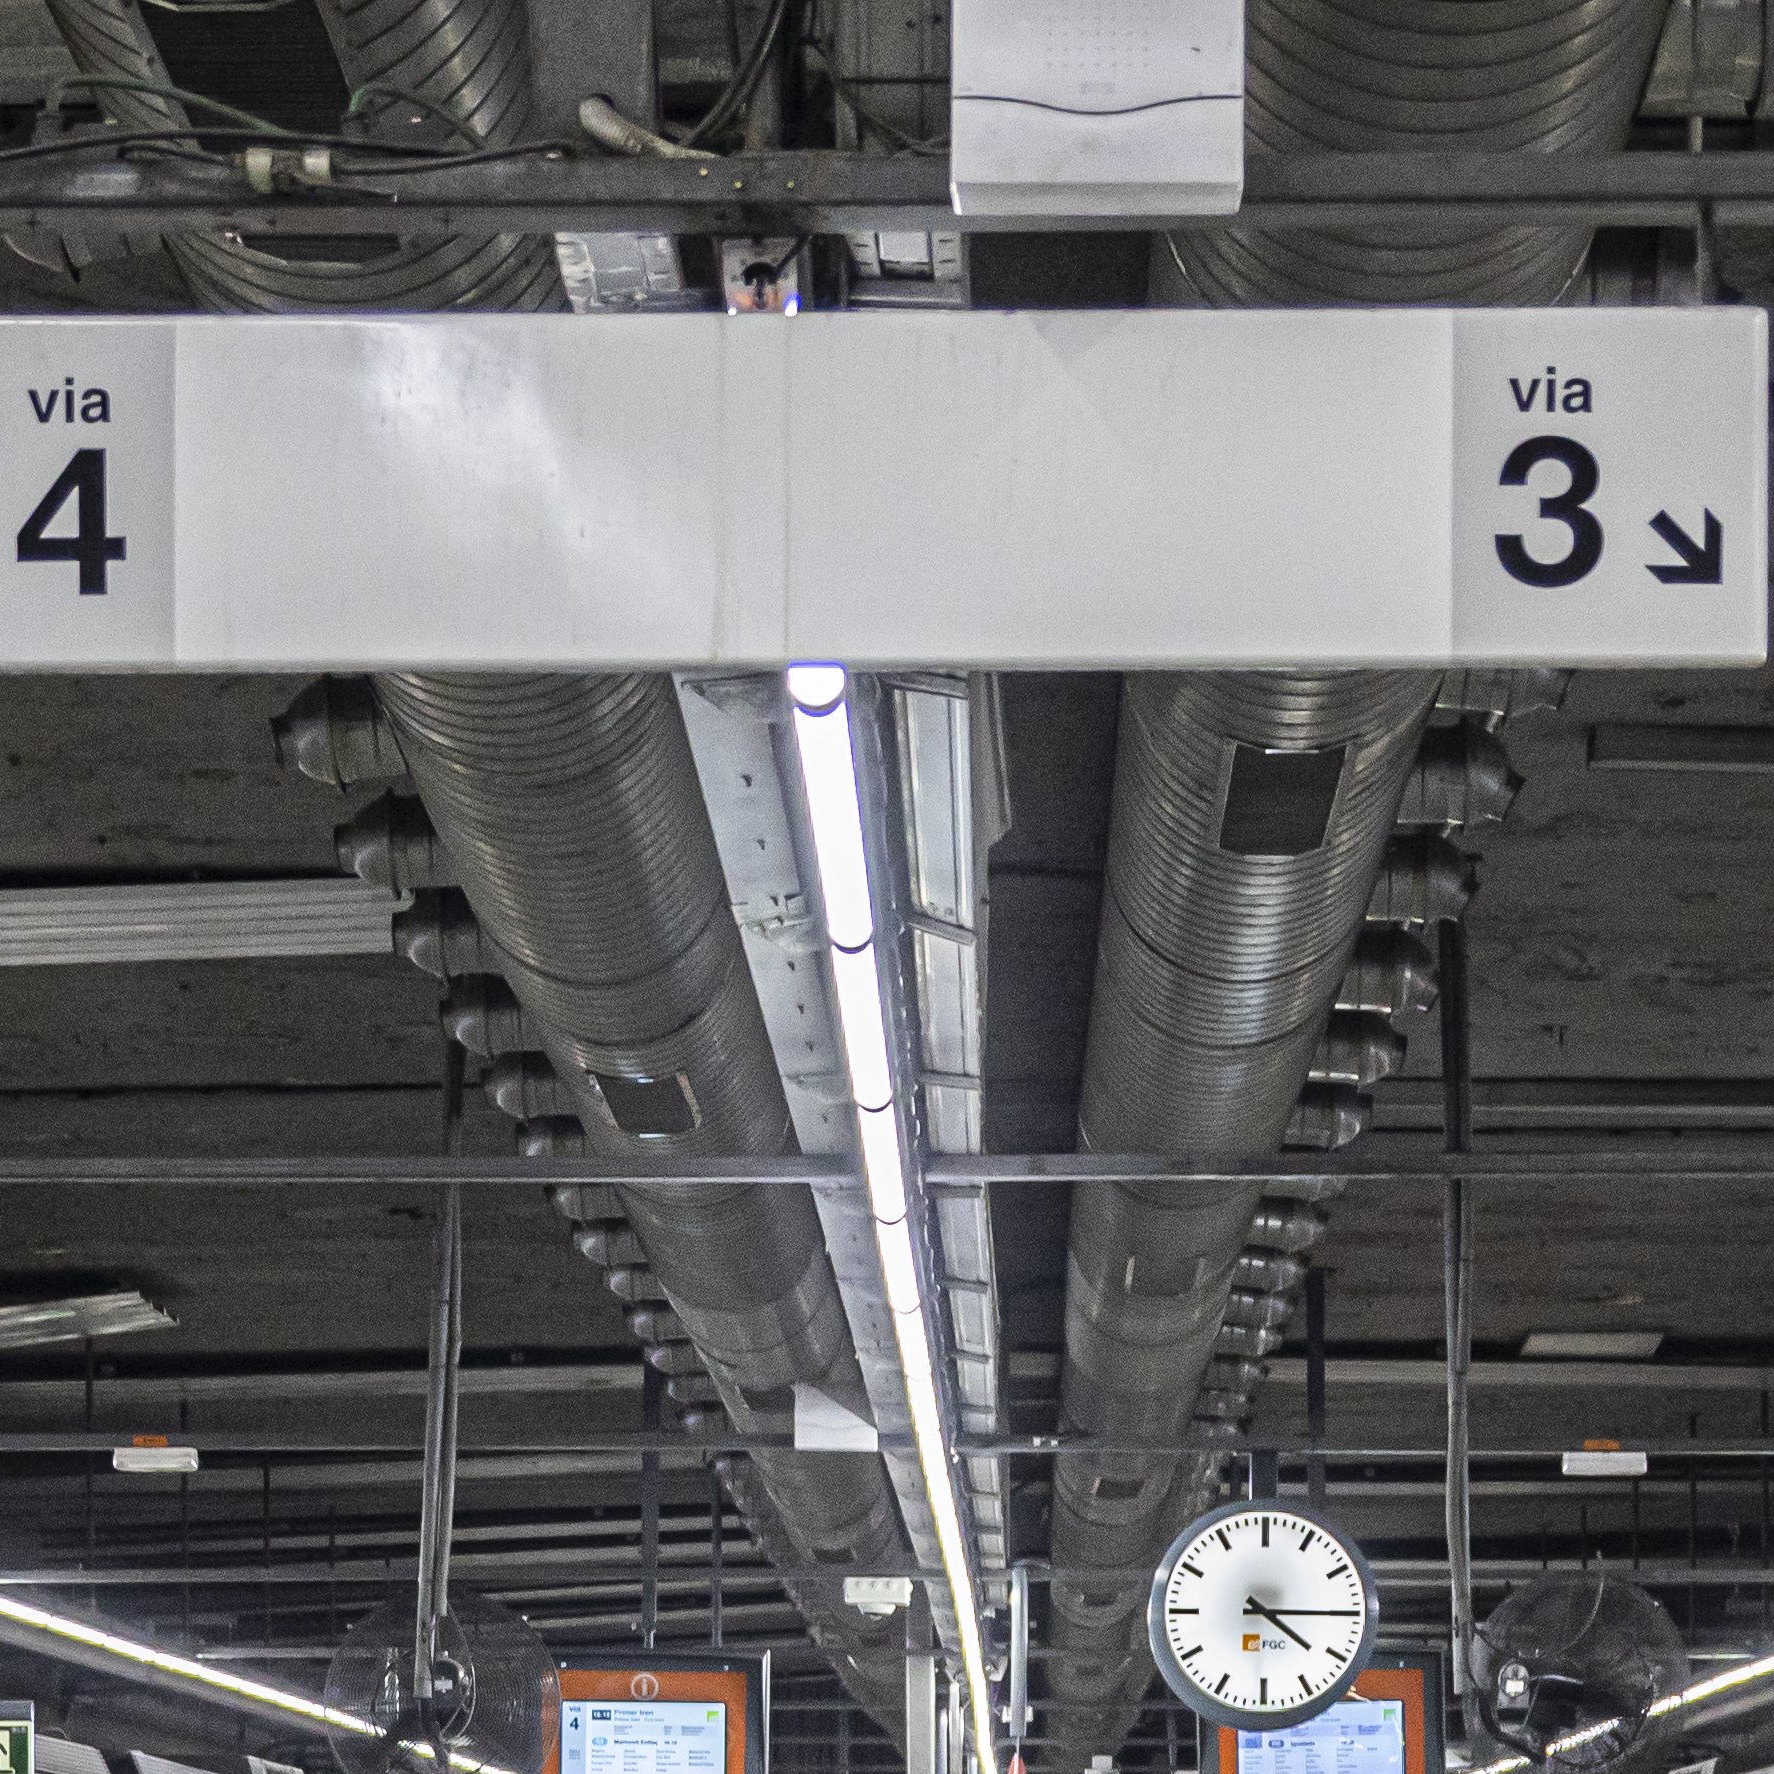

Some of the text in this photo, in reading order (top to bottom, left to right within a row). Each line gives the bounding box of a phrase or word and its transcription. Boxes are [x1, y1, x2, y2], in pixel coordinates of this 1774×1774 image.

[27, 376, 113, 424] via
[1508, 366, 1594, 414] via
[15, 447, 128, 597] 4
[1493, 434, 1605, 589] 3
[1262, 1640, 1286, 1650] FGC
[569, 1716, 580, 1731] 4
